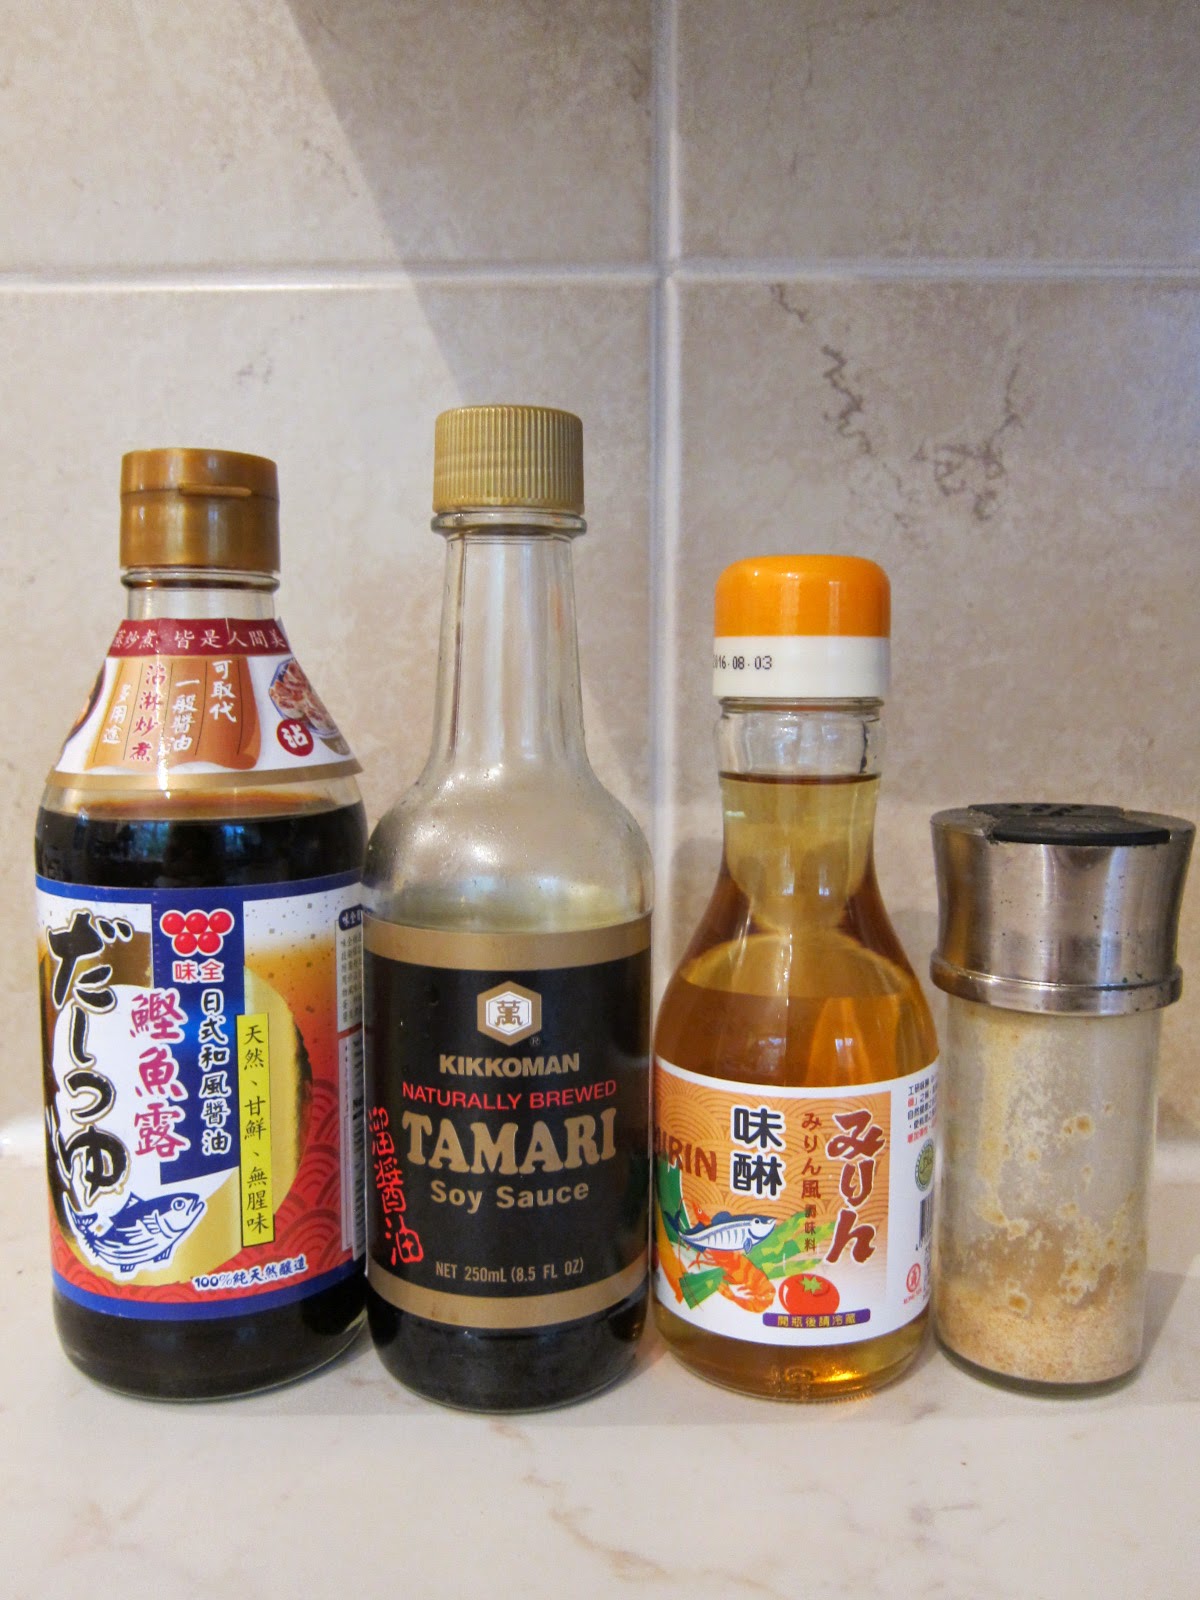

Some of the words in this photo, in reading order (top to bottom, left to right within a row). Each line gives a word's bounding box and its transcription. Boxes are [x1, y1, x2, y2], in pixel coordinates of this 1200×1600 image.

[208, 659, 238, 723] 可取代
[173, 960, 224, 983] 味全
[129, 989, 190, 1159] 鰹魚露
[199, 990, 231, 1155] 日式和風醬油
[402, 1081, 522, 1110] NATURALLY
[529, 1079, 617, 1109] BREWED
[439, 1053, 580, 1078] KIKKOMAN
[401, 1107, 617, 1176] TAMARI
[732, 1107, 784, 1197] 味醂
[430, 1179, 483, 1215] Soy
[496, 1182, 590, 1209] Sauce
[826, 1109, 886, 1264] みりん
[435, 1261, 458, 1280] NET
[464, 1265, 508, 1283] 250mL
[511, 1266, 537, 1284] (8.5
[543, 1263, 558, 1280] FL
[564, 1256, 585, 1276] OZ)
